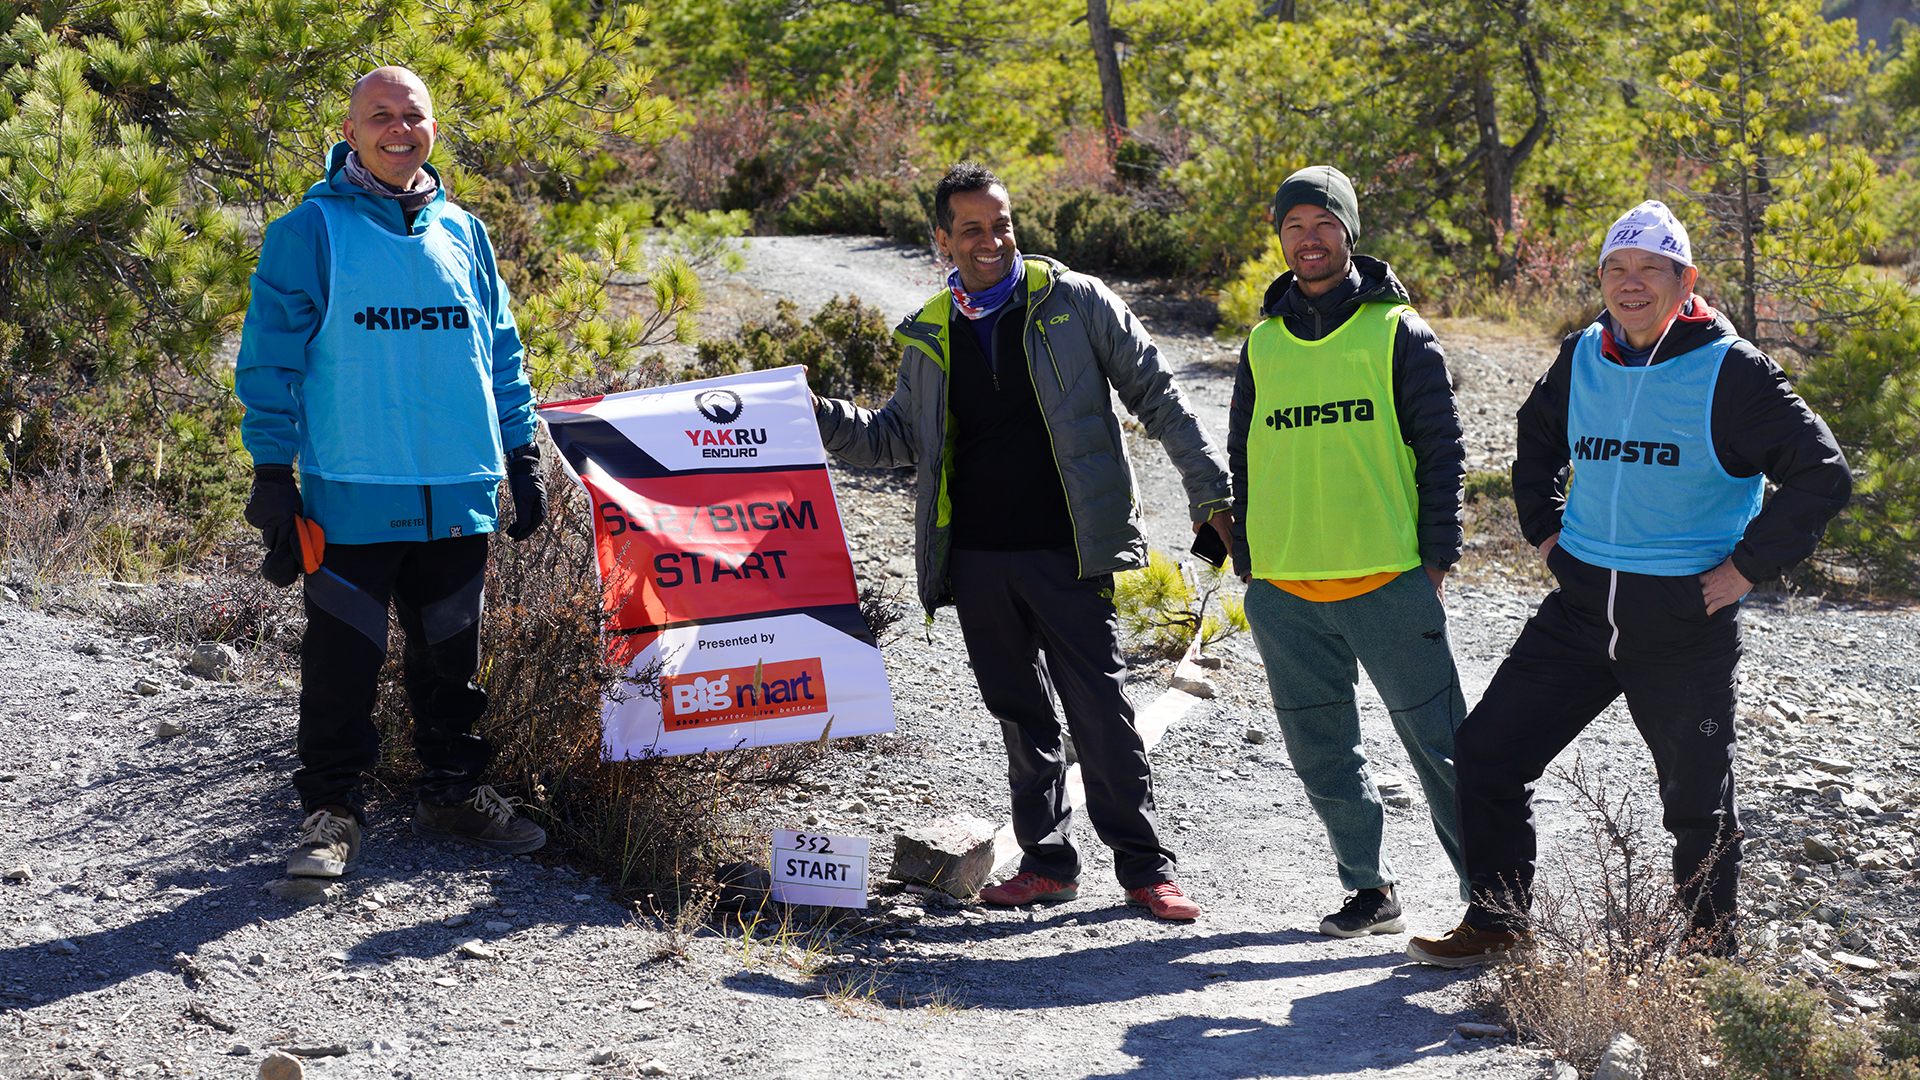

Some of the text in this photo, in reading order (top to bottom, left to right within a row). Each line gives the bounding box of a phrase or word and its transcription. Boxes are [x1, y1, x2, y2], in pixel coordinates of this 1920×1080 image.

[1612, 229, 1643, 242] FLY
[366, 306, 469, 330] KIPSTA
[1274, 398, 1374, 431] KIPSTA
[684, 428, 768, 447] YAKRU
[702, 447, 758, 458] ENDURO
[1577, 435, 1680, 466] KIPSTA
[390, 518, 425, 528] GORE-TEX
[654, 550, 788, 589] START
[698, 632, 775, 650] Presented by
[671, 671, 815, 716] Big mart
[676, 704, 815, 726] Shop smarter. Live better.
[795, 834, 834, 854] SS2
[786, 858, 851, 881] START
